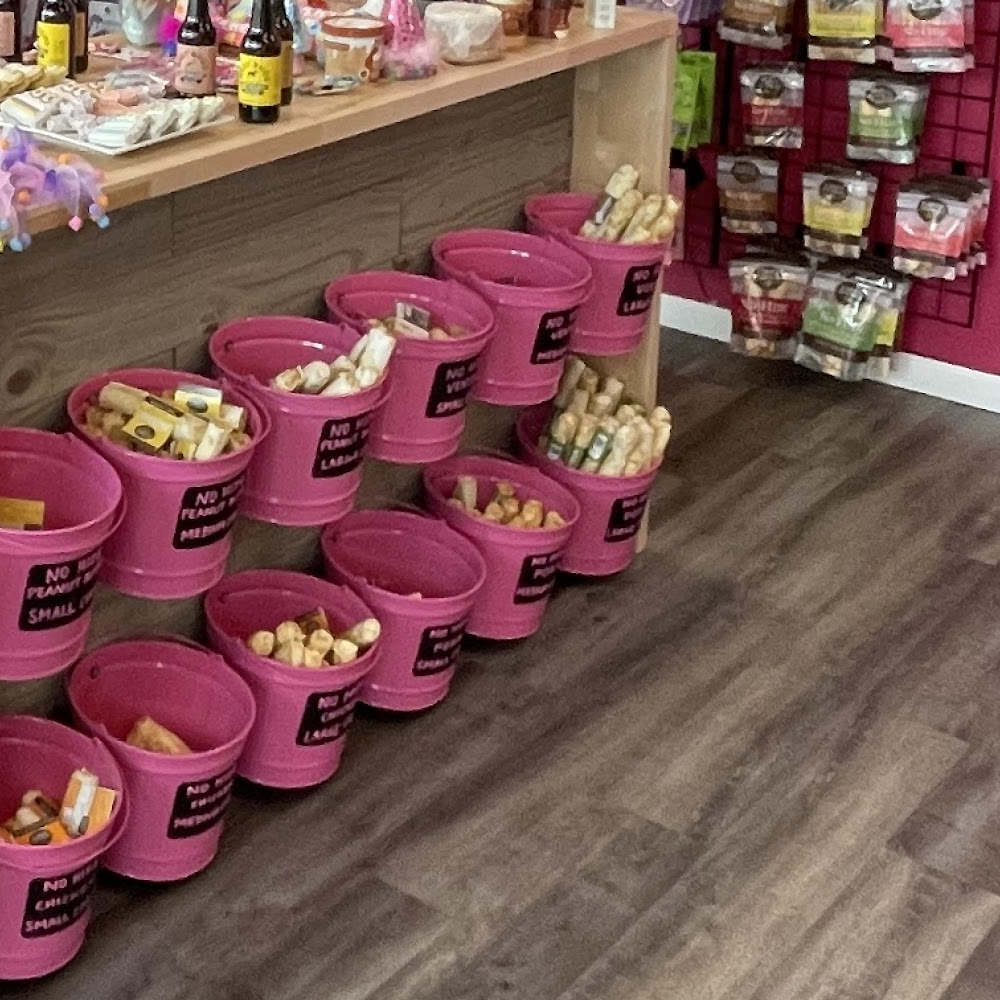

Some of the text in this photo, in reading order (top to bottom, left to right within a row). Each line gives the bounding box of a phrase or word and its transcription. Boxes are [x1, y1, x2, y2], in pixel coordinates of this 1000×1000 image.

[45, 565, 70, 585] NO
[26, 576, 82, 600] PEANUT
[27, 601, 77, 625] SMALL
[43, 878, 68, 893] NO
